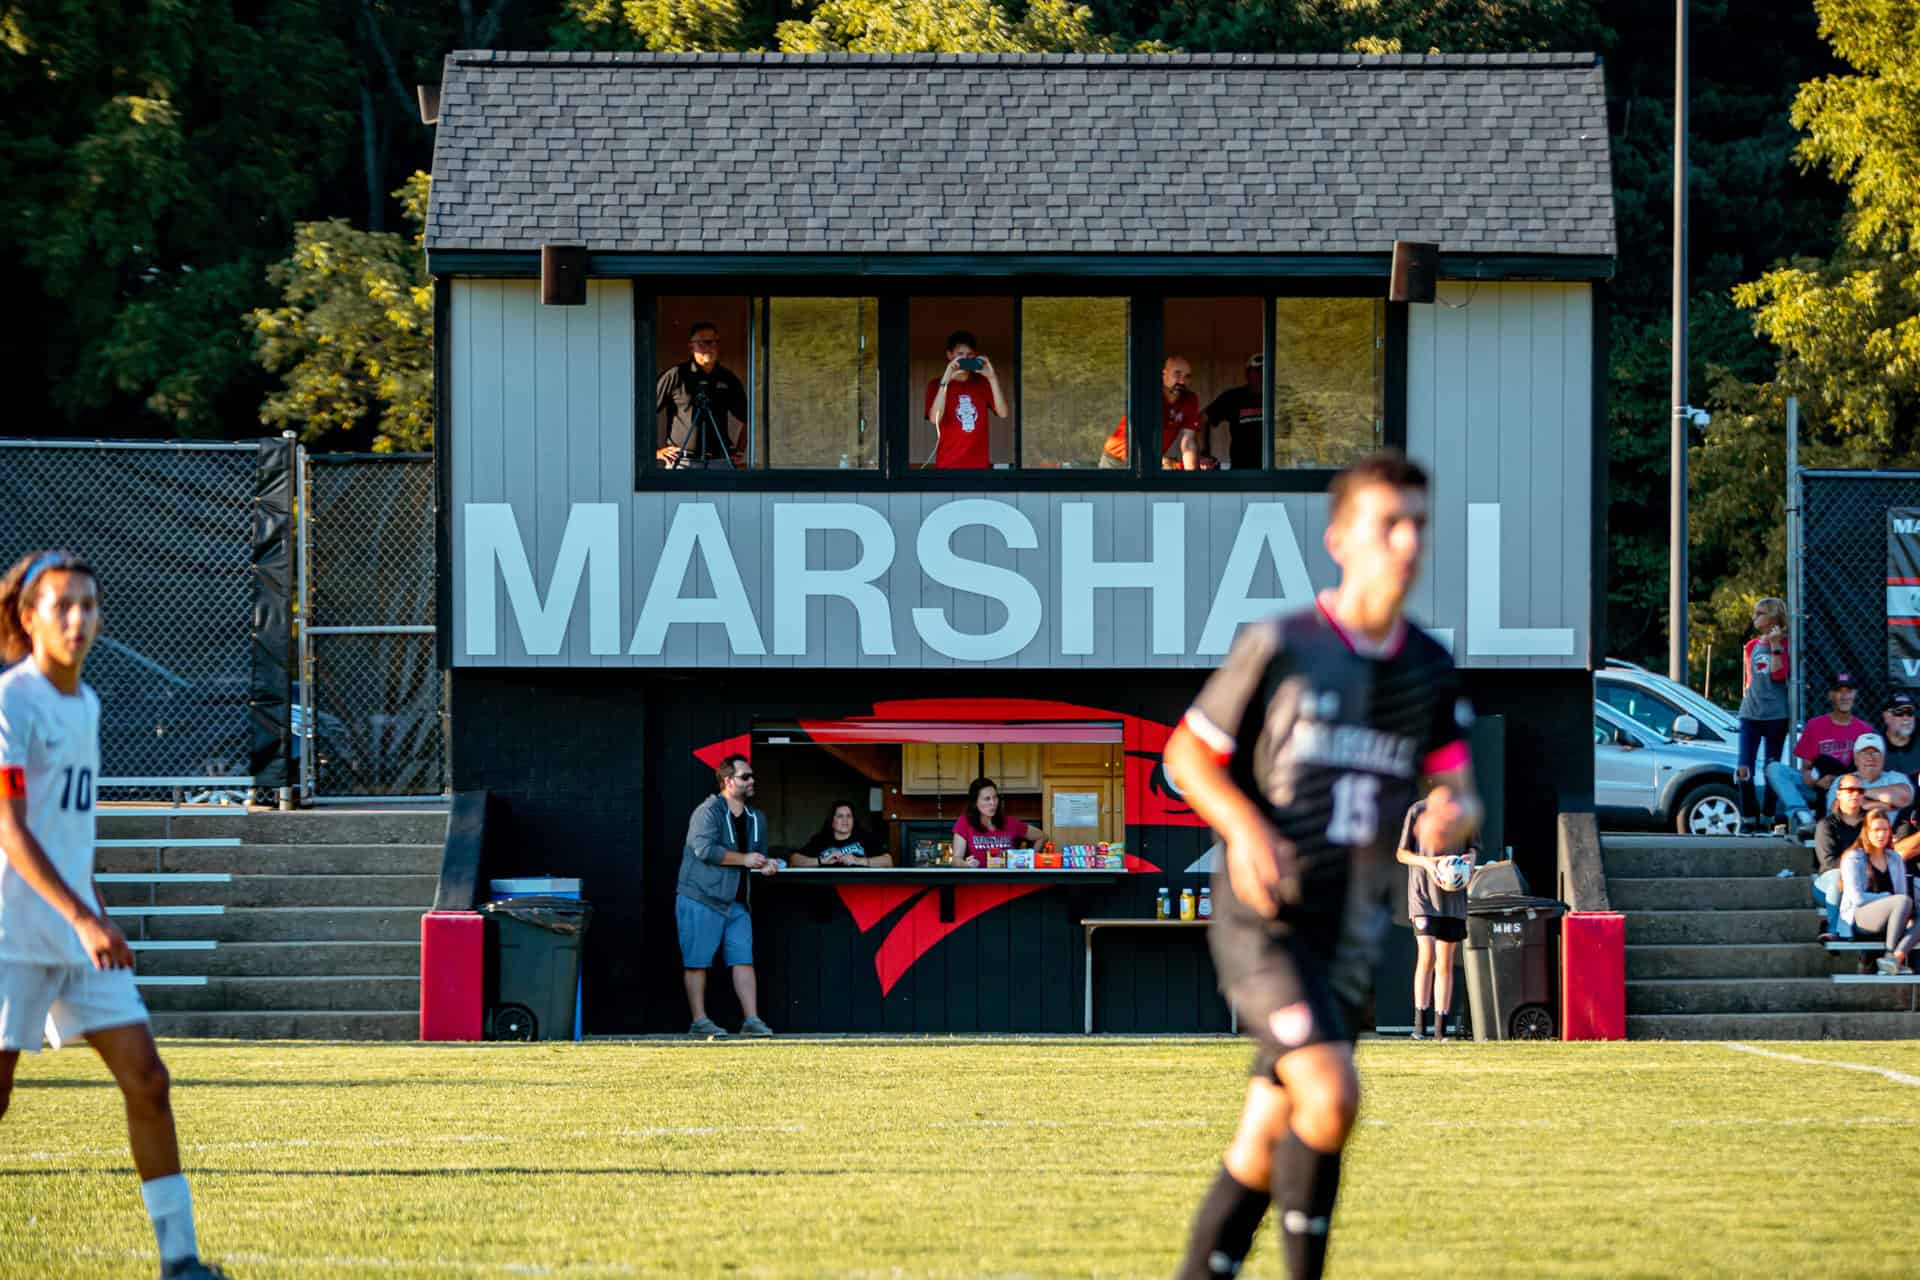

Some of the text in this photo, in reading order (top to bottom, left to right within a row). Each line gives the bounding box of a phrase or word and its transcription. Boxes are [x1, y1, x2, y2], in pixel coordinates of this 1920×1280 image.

[464, 498, 1574, 662] MARSHAL
[61, 765, 92, 811] 10
[1327, 773, 1379, 845] 15
